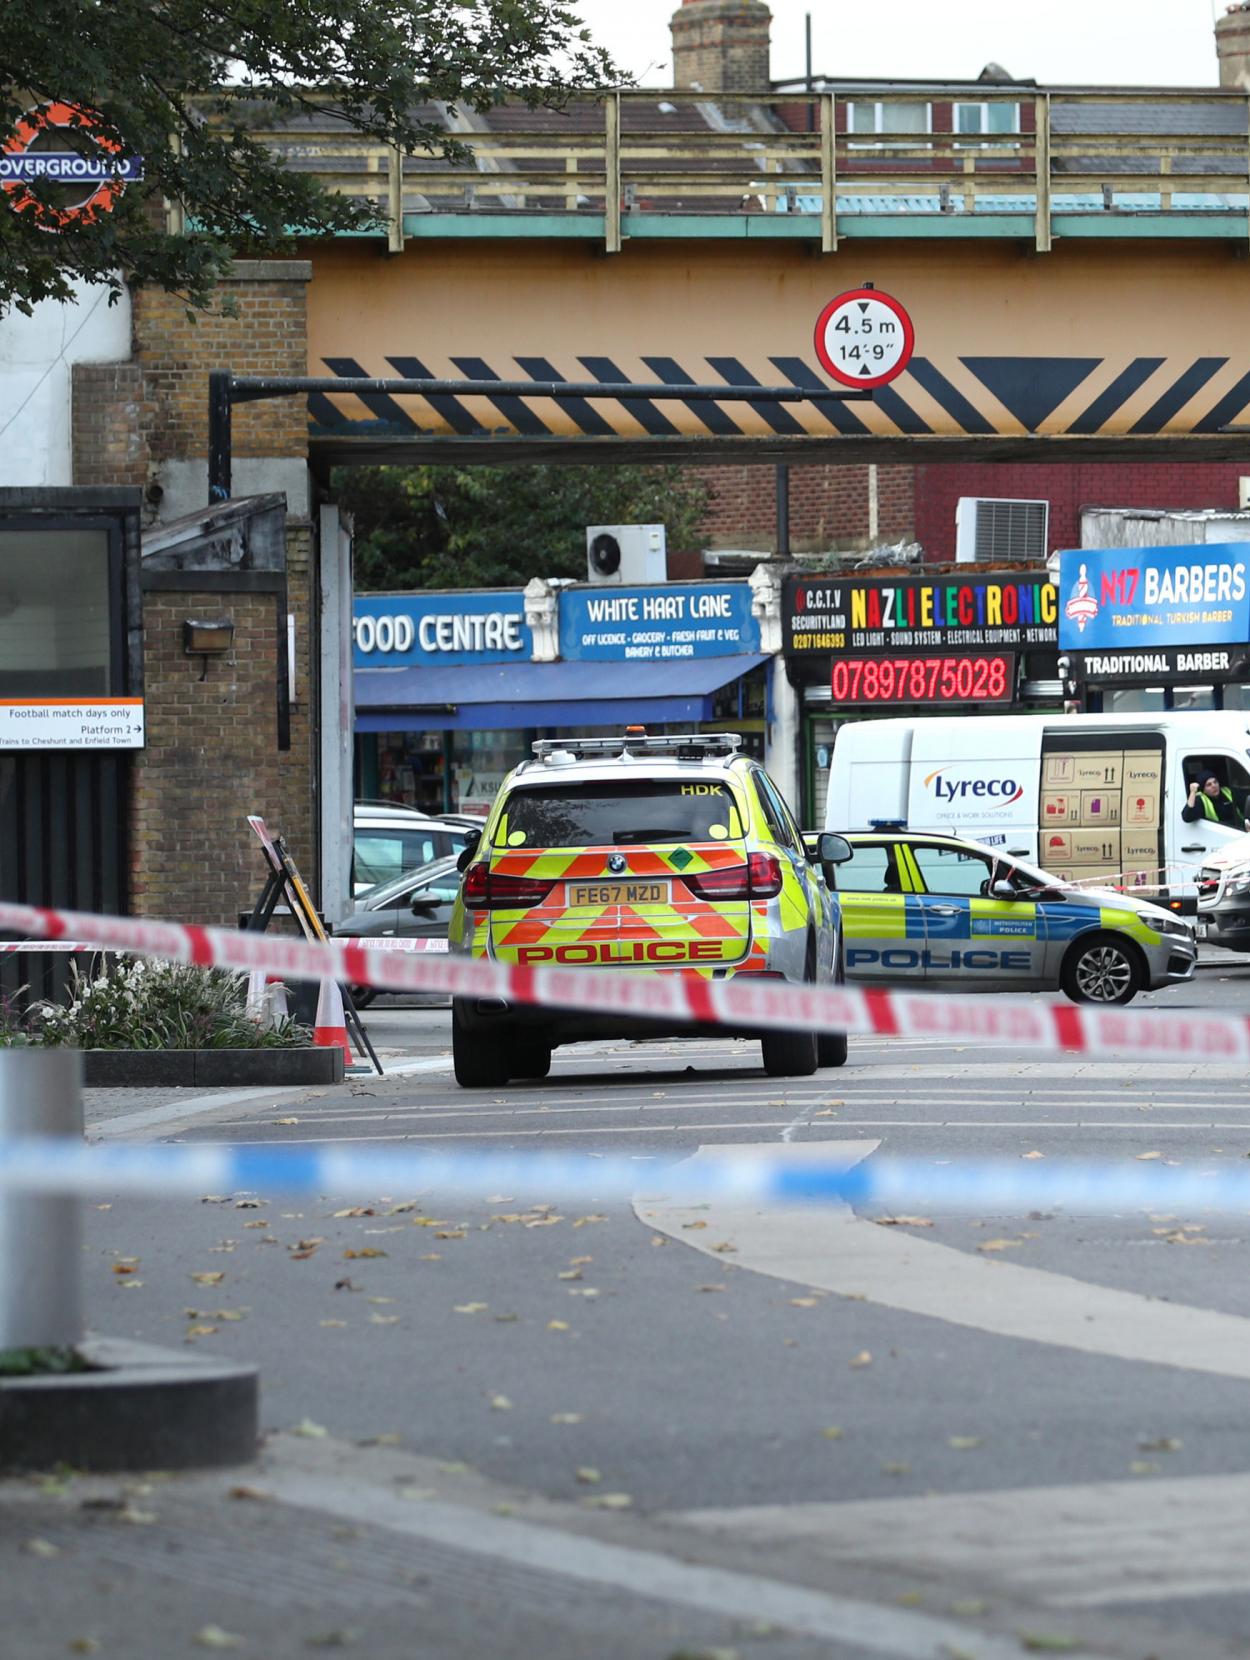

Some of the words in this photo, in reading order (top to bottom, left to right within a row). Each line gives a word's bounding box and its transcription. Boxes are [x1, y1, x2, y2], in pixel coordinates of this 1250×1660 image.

[835, 315, 873, 334] 4.5
[879, 321, 896, 333] m
[1101, 567, 1141, 607] N17
[1144, 563, 1246, 605] BARBERS
[587, 598, 639, 622] WHITE
[643, 595, 686, 620] HART
[690, 594, 732, 618] LANE
[806, 588, 841, 609] C.C.T.V
[851, 586, 917, 629] NAZLI
[921, 583, 1057, 627] ELECTRONIC
[792, 615, 846, 630] SECURITYLAND
[1112, 614, 1163, 627] TRADITIONAL
[1167, 612, 1200, 624] TURKISH
[1202, 610, 1233, 623] BARBER
[418, 612, 524, 651] CENTRE
[582, 634, 597, 646] OFF
[597, 632, 627, 646] LICENCE
[632, 631, 666, 644] GROCERY
[672, 630, 696, 642] FRESH
[696, 629, 716, 641] FRUIT
[724, 628, 740, 640] VEG
[853, 633, 864, 647] LED
[866, 631, 885, 646] LIGHT
[891, 631, 913, 646] SOUND
[914, 630, 941, 645] SYSTEM
[947, 630, 984, 645] ELECTRICAL
[985, 629, 1021, 643] EQUIPMENT
[1026, 628, 1057, 643] NETWORK
[625, 646, 654, 658] BAKERY
[661, 644, 694, 657] BUTCHER
[1084, 655, 1170, 674] TRADITIONAL
[1177, 652, 1230, 671] BARBER
[832, 657, 1006, 700] 07897875028
[10, 709, 49, 718] Football
[53, 708, 83, 717] match
[86, 708, 107, 719] days
[111, 708, 131, 719] only
[81, 725, 123, 734] Platform
[126, 725, 131, 734] 2
[22, 737, 30, 745] to
[32, 737, 67, 745] Cheshunt
[69, 737, 83, 745] and
[1129, 771, 1156, 779] Lyreco
[681, 785, 724, 796] HDK
[935, 776, 1017, 802] Lyreco
[576, 887, 621, 904] FE67
[626, 885, 661, 901] MZD
[518, 941, 723, 965] POLICE
[847, 949, 1031, 970] POLICE
